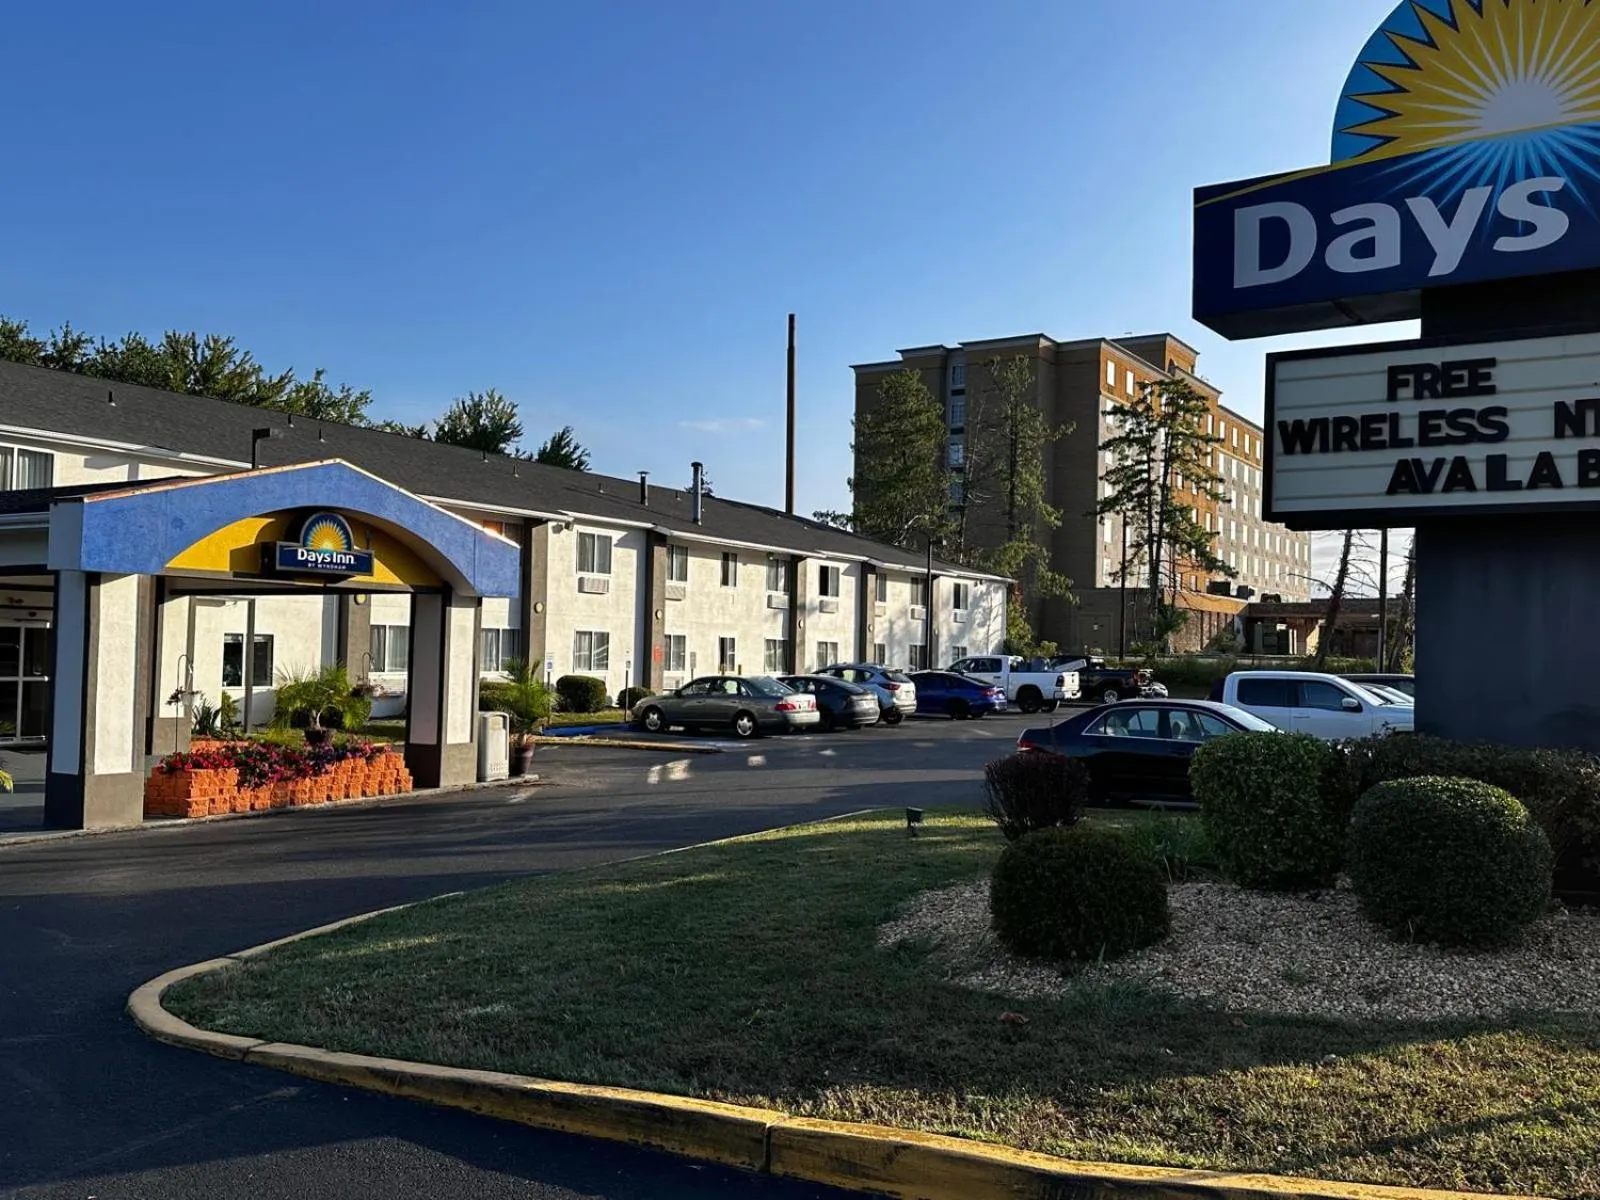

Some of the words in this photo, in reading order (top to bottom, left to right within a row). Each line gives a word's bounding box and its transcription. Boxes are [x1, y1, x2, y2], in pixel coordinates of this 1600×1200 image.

[1233, 176, 1570, 289] Days
[1387, 358, 1497, 401] FREE
[1278, 406, 1510, 455] WIRELESS
[297, 548, 331, 563] Days
[333, 551, 355, 564] Inn
